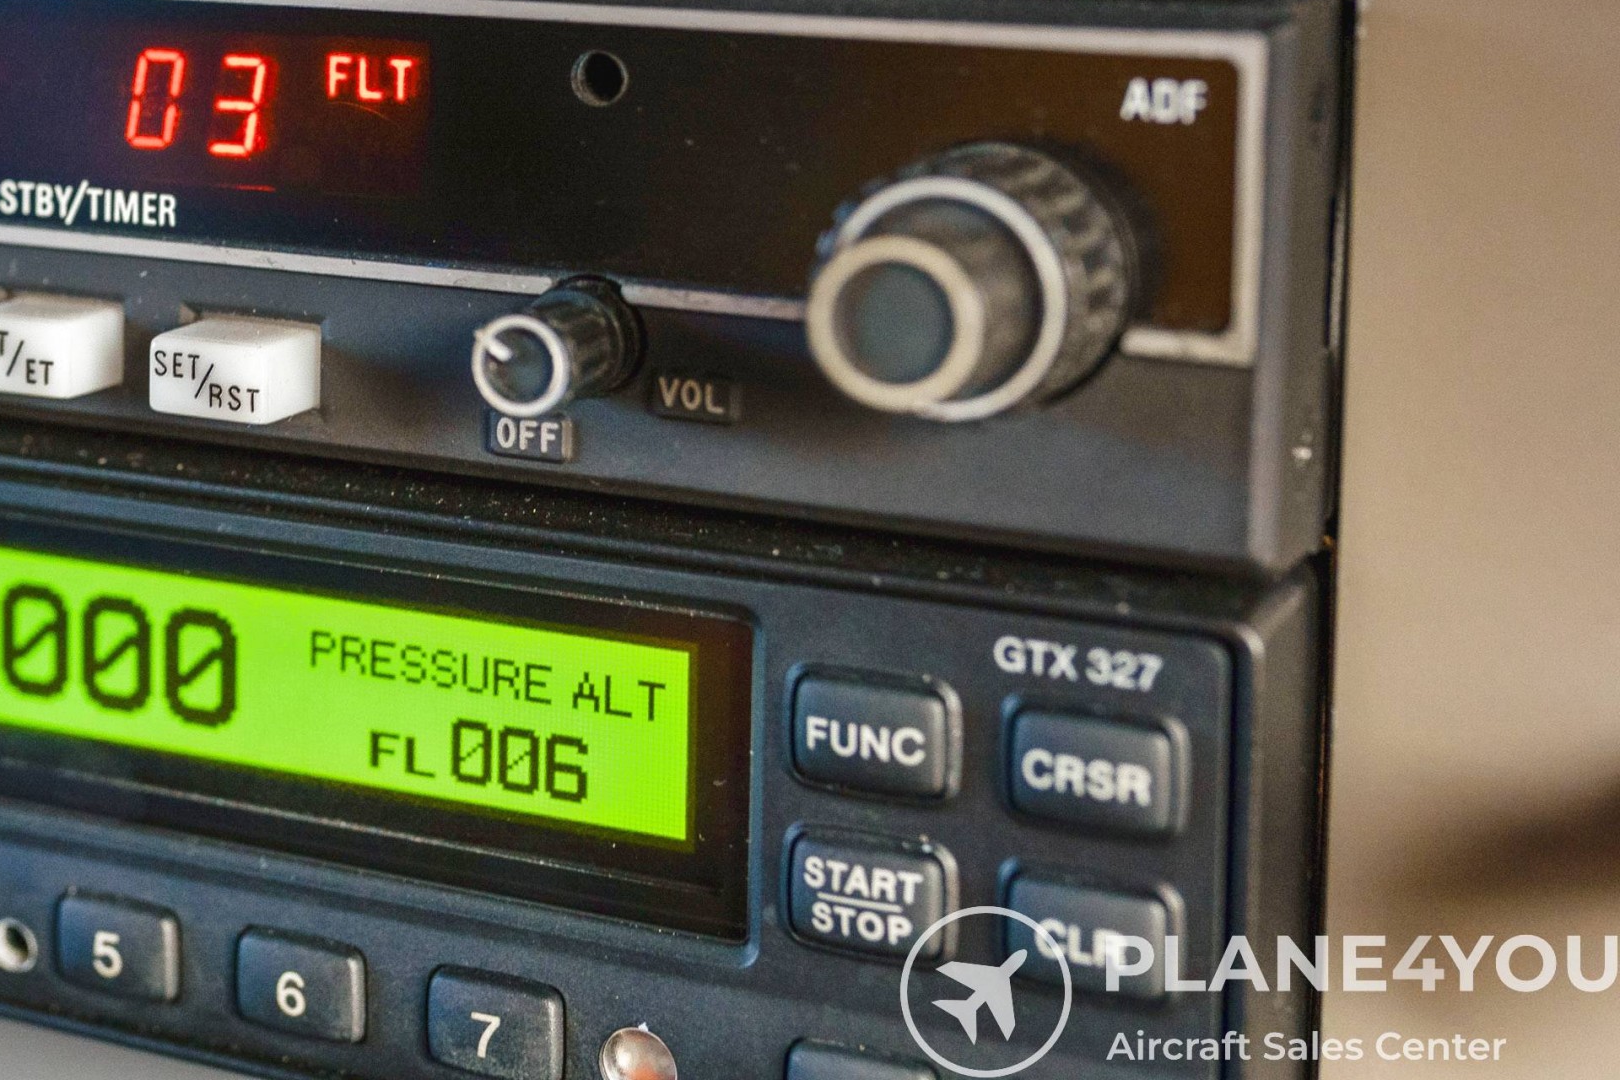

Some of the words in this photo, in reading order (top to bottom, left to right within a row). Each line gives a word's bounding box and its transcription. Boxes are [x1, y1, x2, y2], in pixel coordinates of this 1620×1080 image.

[327, 54, 413, 101] FLT
[1121, 79, 1207, 124] ADF
[153, 348, 260, 415] SET/RST
[658, 376, 725, 414] VOL
[496, 416, 560, 454] OFF
[310, 629, 554, 705] PRESSURE
[572, 672, 665, 720] ALT
[992, 635, 1078, 683] GTX
[1085, 646, 1163, 693] 327
[805, 717, 926, 768] FUNC
[1021, 749, 1152, 808] CRSR
[803, 856, 924, 904] START
[810, 905, 913, 946] STOP
[92, 932, 123, 978] 5
[276, 970, 306, 1017] 6
[470, 1011, 501, 1059] 7
